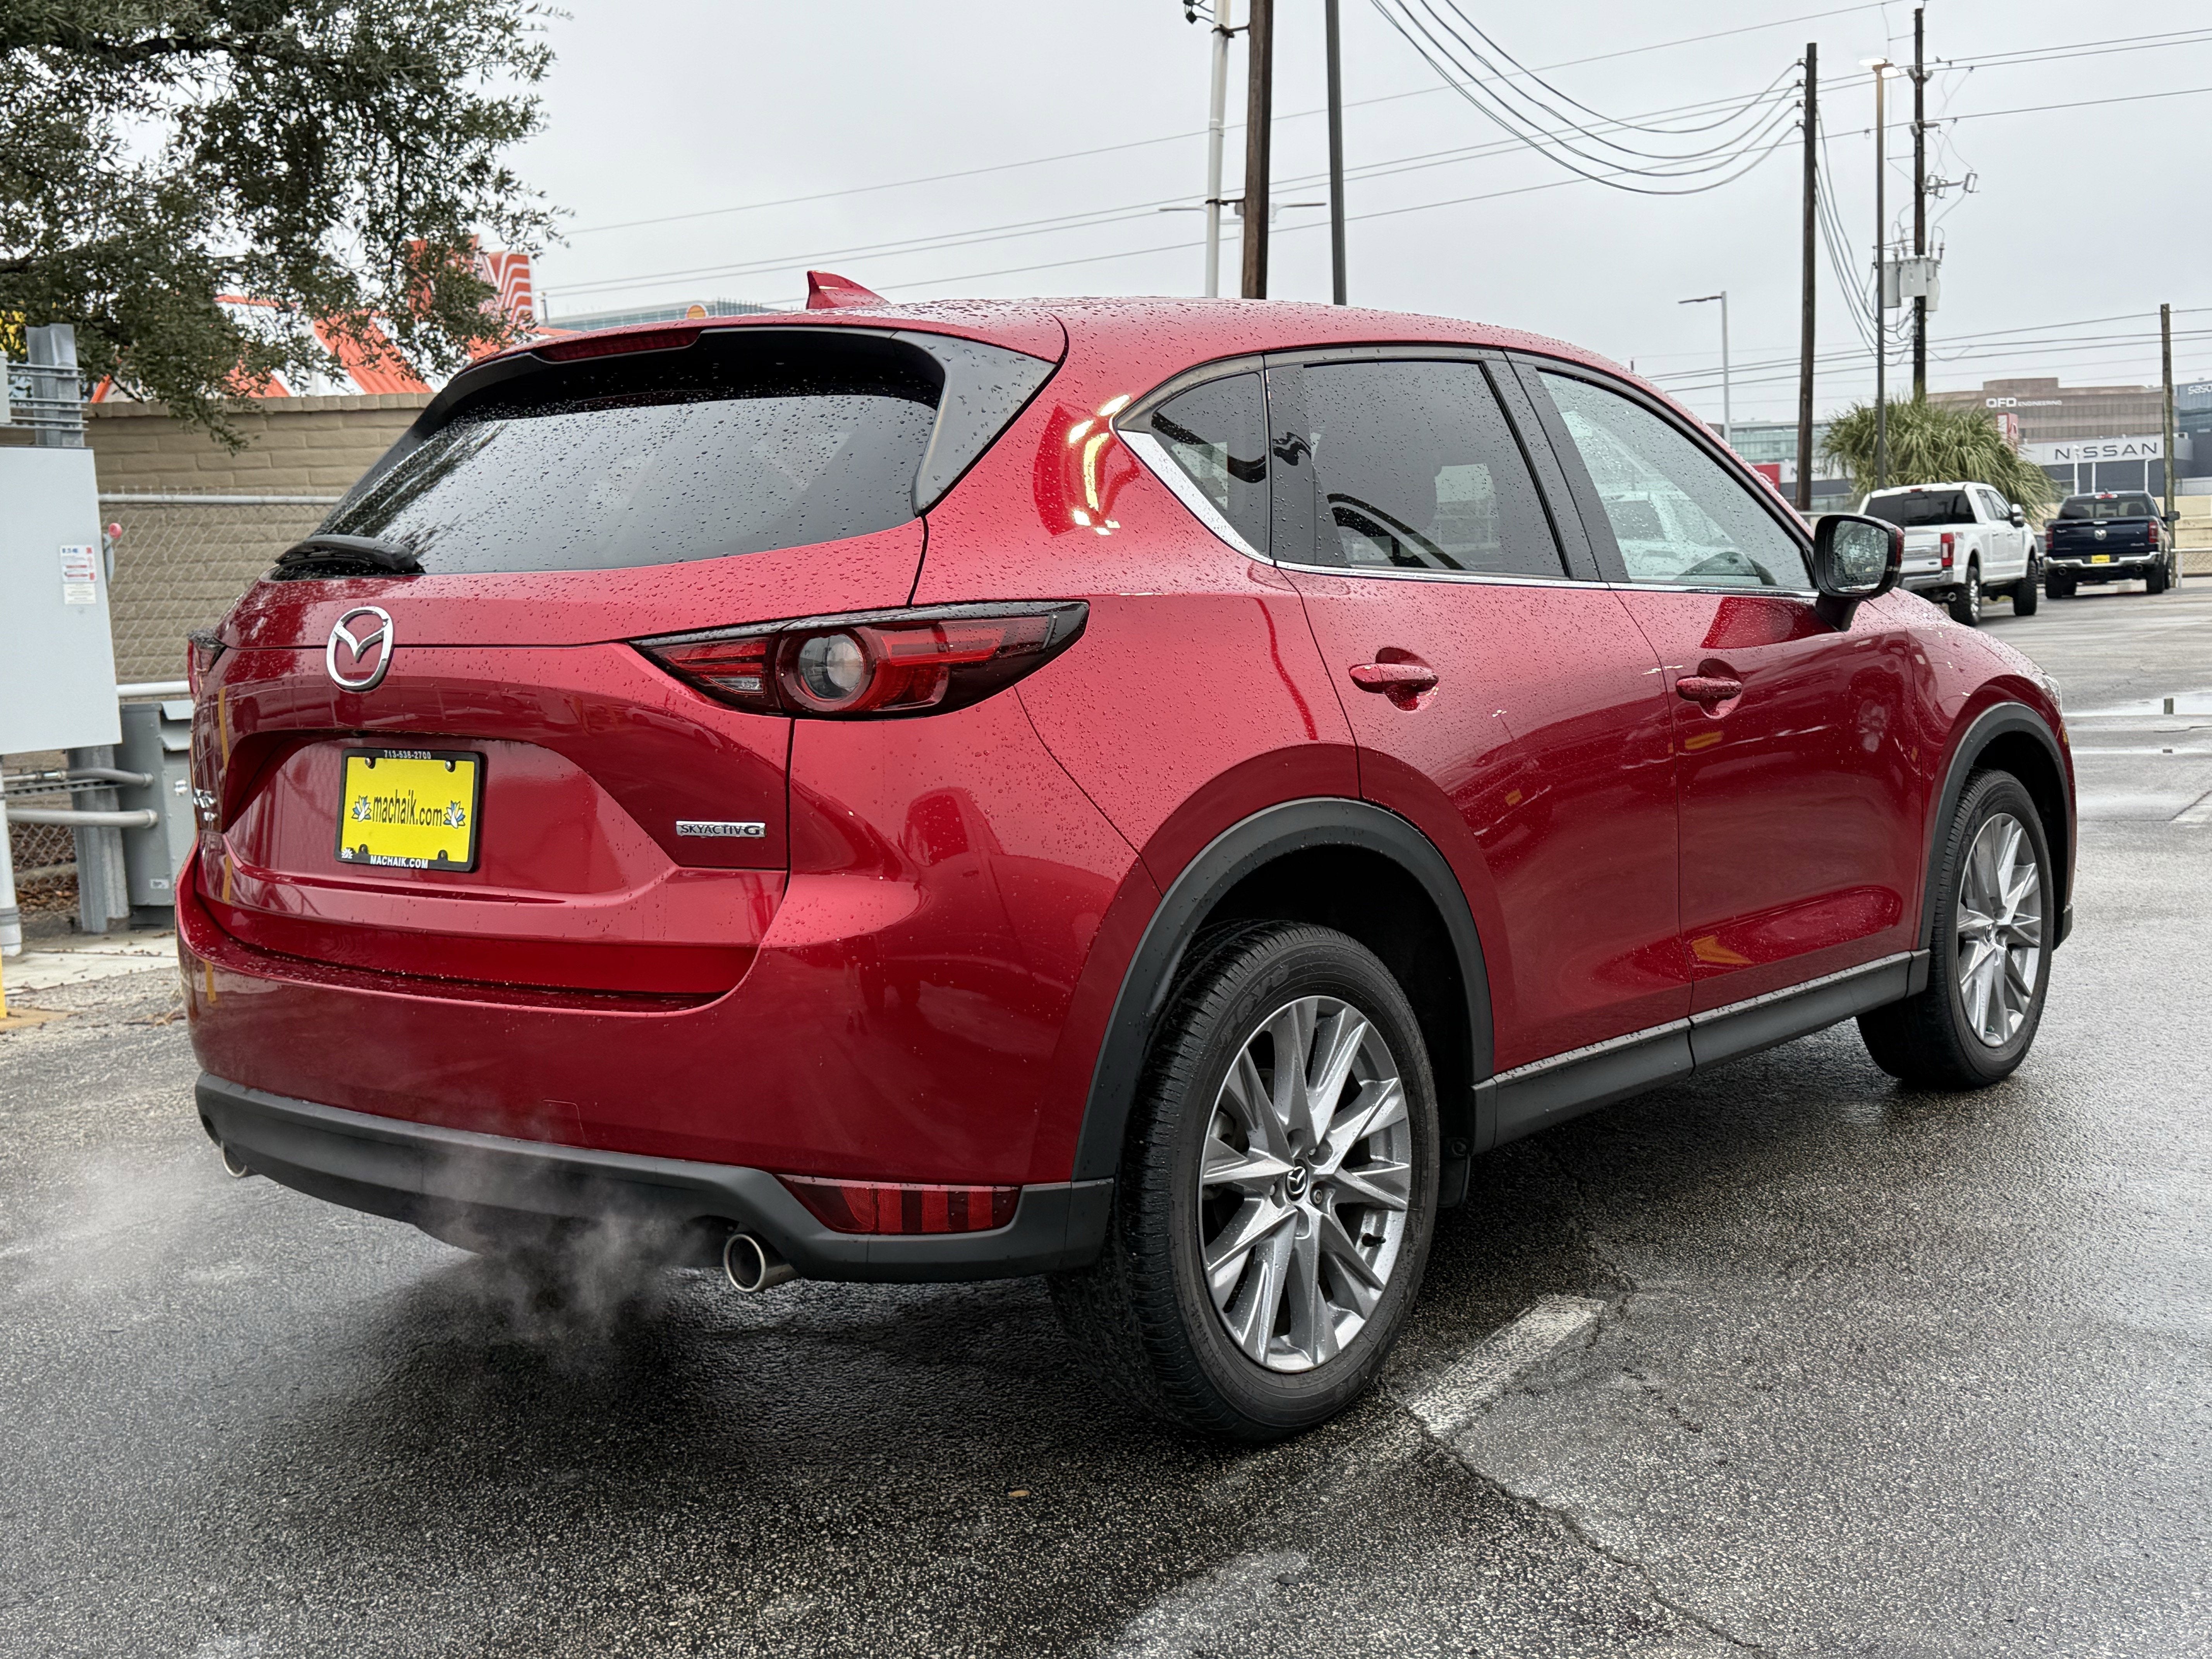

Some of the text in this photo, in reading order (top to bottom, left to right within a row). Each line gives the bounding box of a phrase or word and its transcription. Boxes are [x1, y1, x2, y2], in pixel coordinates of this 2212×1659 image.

[1986, 397, 2016, 408] OFD
[372, 789, 443, 827] machaik.com
[370, 855, 428, 869] MACHAIK.COM
